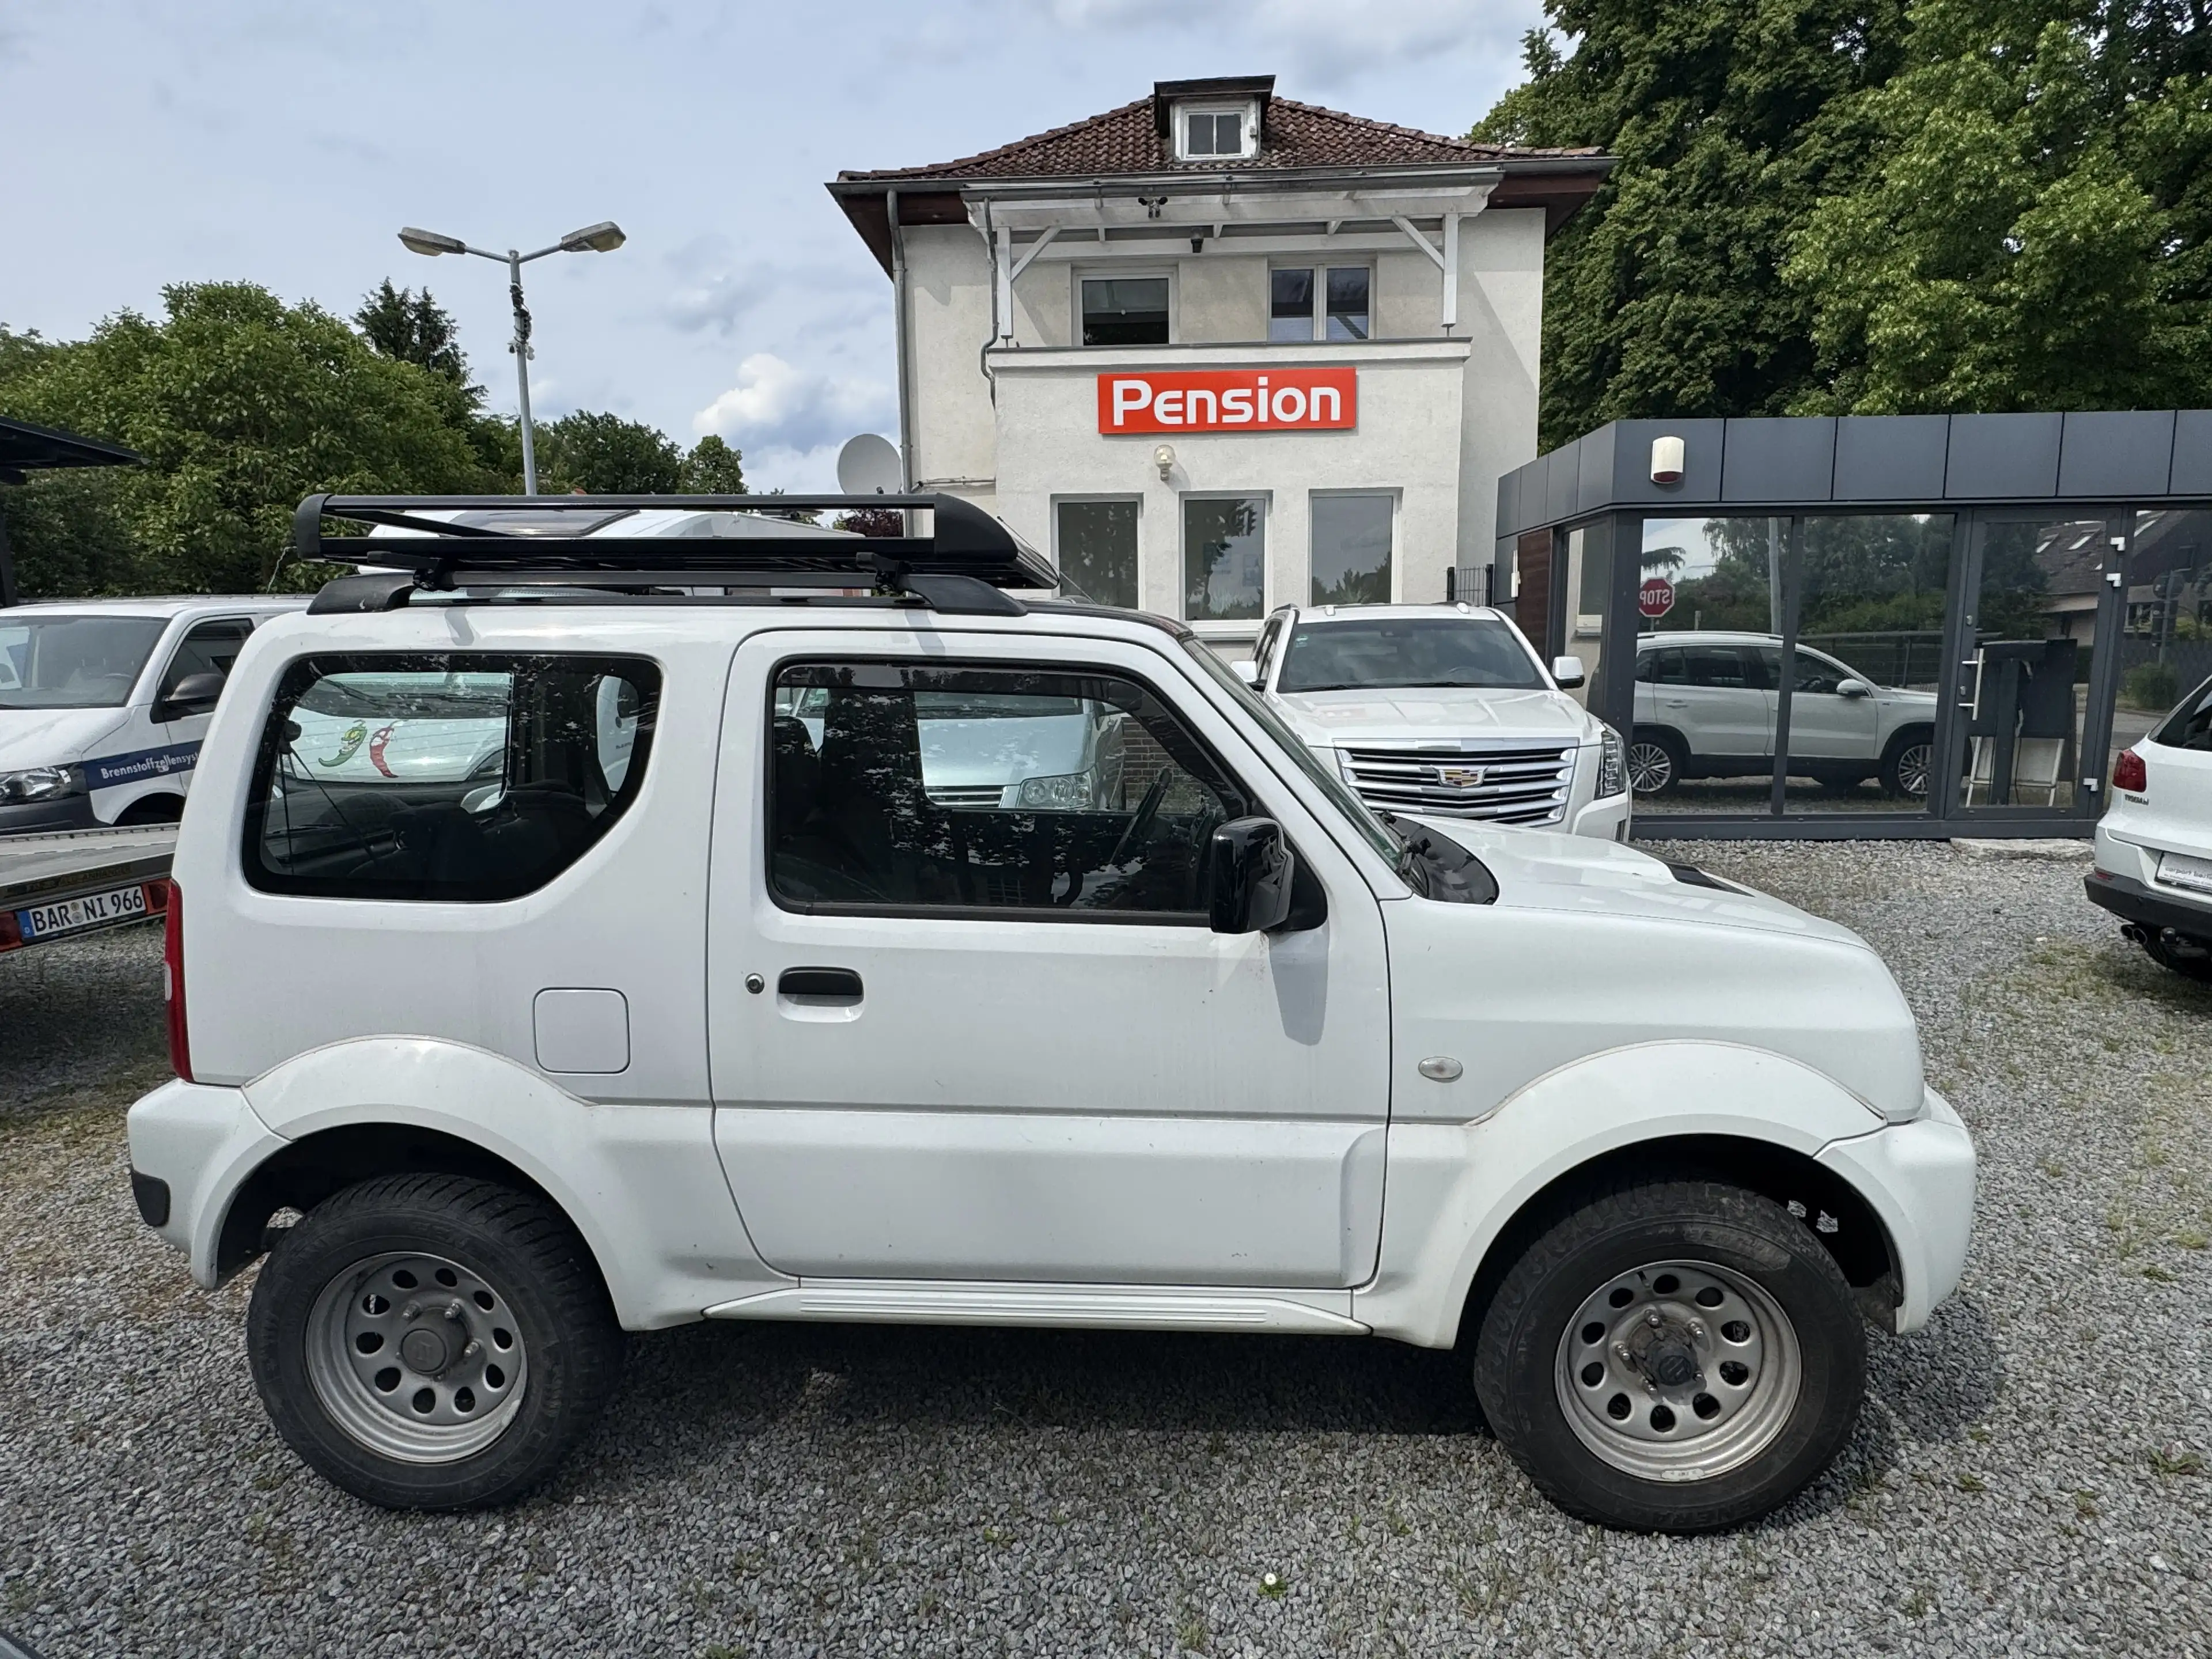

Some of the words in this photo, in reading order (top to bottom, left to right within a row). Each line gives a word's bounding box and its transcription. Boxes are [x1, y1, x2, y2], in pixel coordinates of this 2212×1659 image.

[1112, 376, 1341, 426] Pension
[32, 906, 73, 932] BAR
[83, 897, 108, 921] NI
[111, 889, 143, 914] 966
